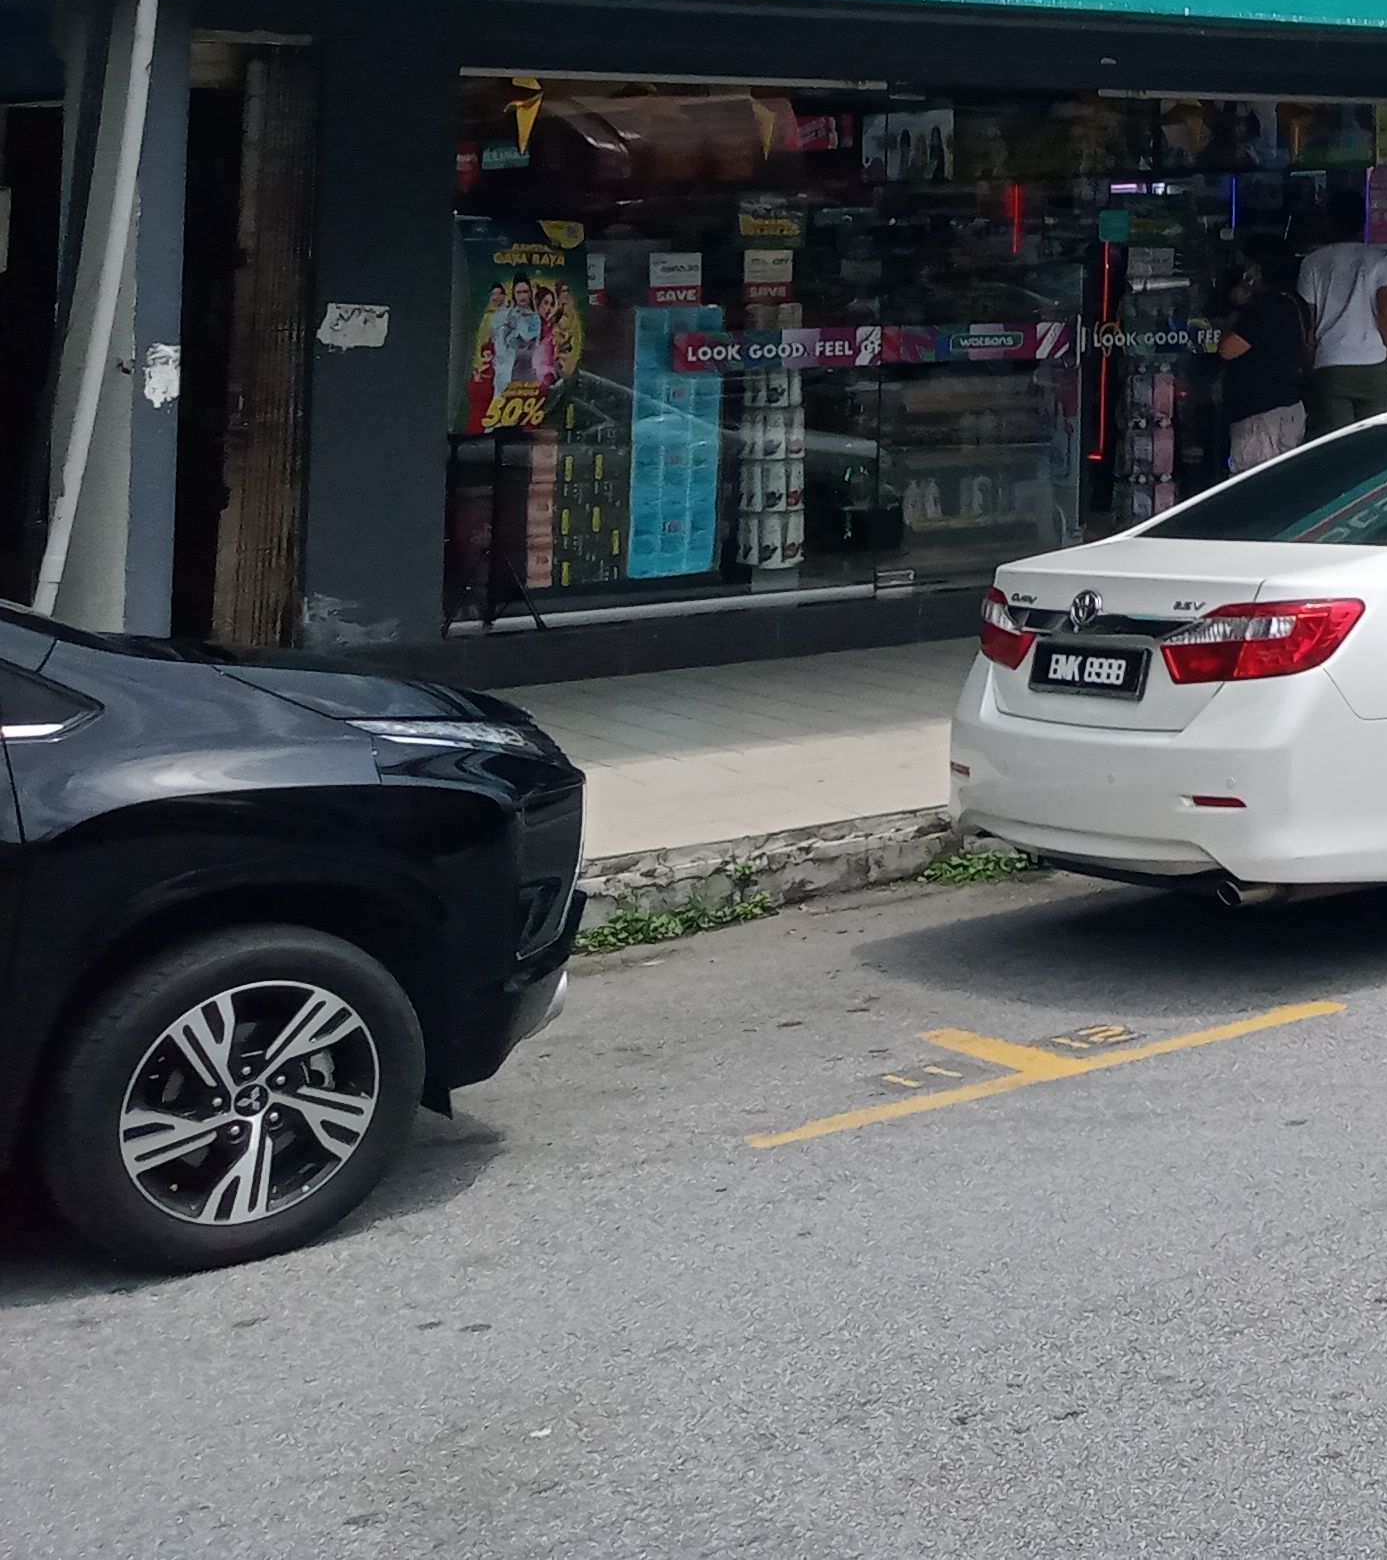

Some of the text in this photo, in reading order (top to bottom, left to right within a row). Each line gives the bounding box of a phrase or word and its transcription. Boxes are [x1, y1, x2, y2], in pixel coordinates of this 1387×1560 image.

[655, 289, 697, 302] SAVE
[958, 336, 1015, 348] watsons
[1093, 331, 1138, 349] LOOK
[687, 344, 742, 362] LOOK
[748, 342, 808, 360] GOOD.
[815, 340, 854, 357] FEEL
[482, 396, 546, 428] 50%
[1047, 652, 1084, 682] BMK
